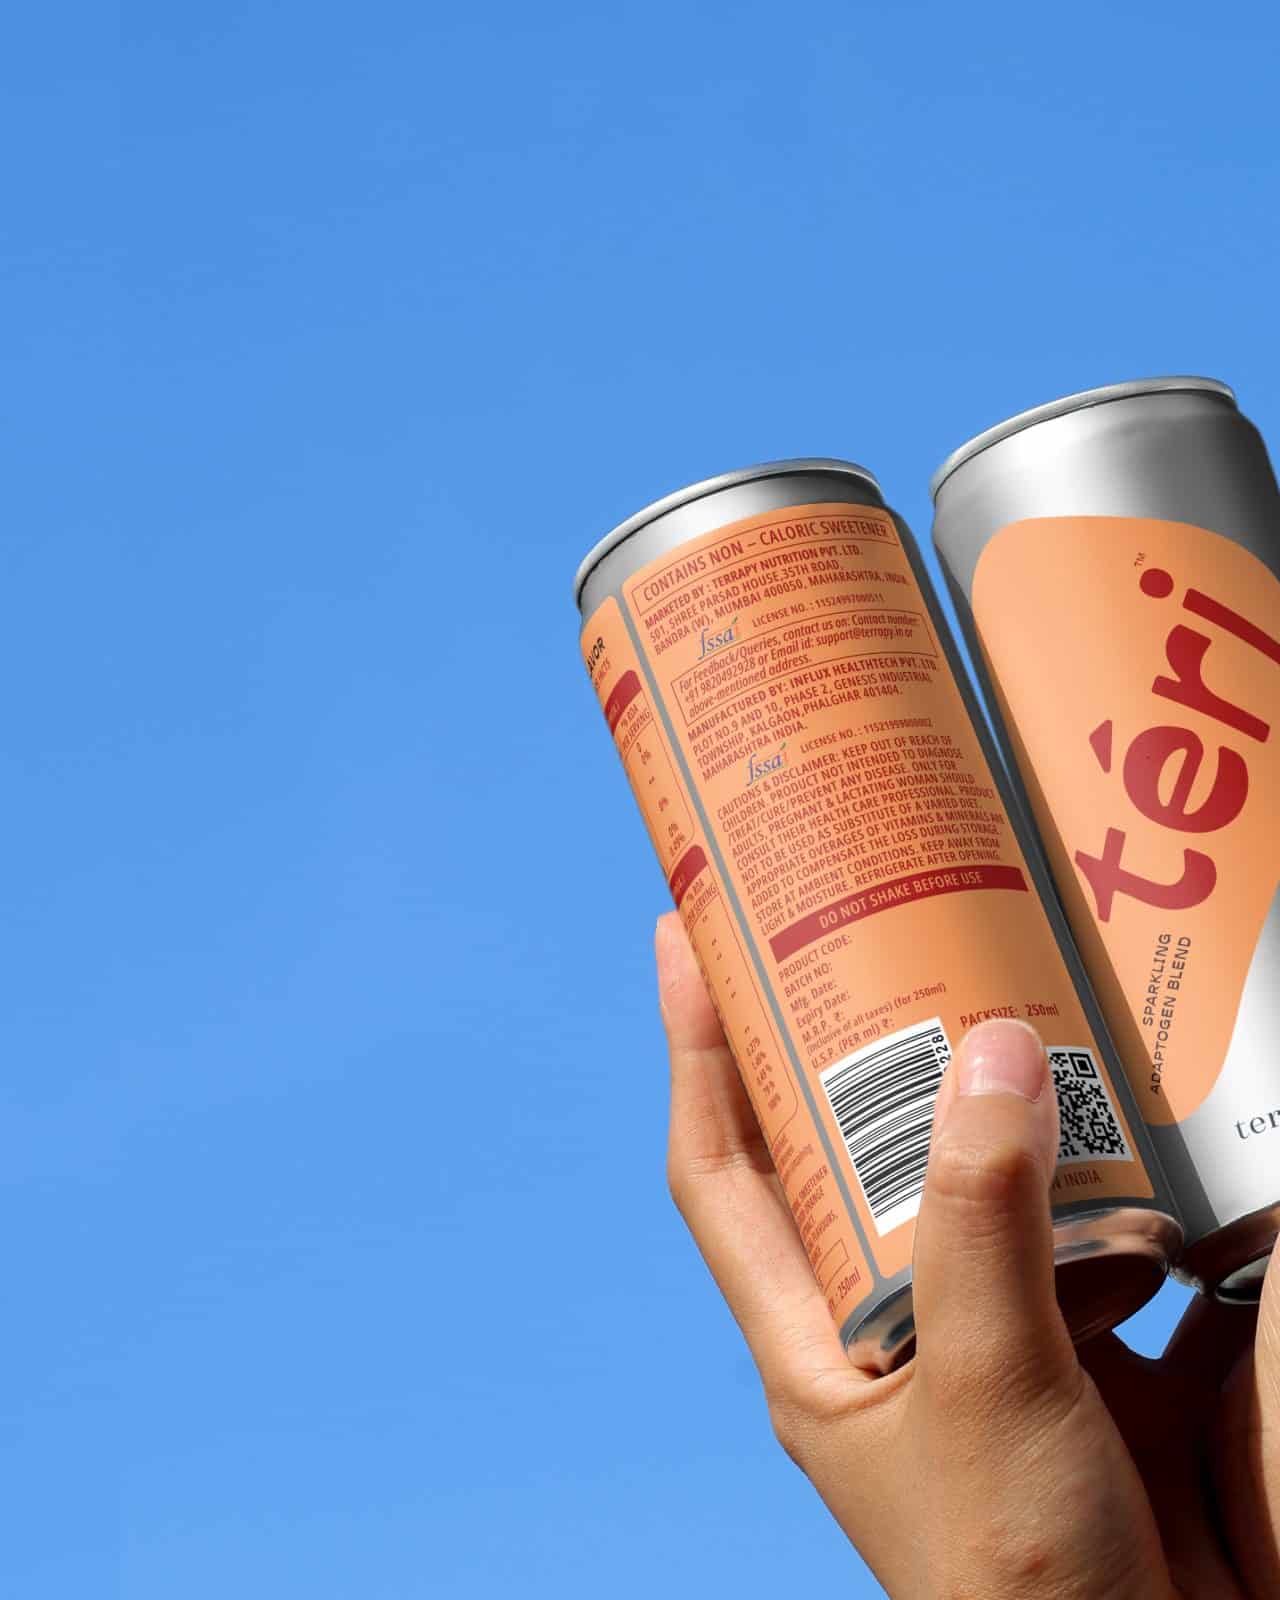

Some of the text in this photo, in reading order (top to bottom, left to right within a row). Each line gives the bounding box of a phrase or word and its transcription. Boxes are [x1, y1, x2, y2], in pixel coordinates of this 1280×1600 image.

[643, 556, 706, 602] CONTAINS
[709, 541, 743, 564] NON
[759, 525, 818, 546] CALORIC
[821, 524, 888, 537] SWEETENER
[645, 549, 818, 629] MARKETED BY TERRAPY NUTRITION
[655, 626, 690, 655] BANDRA
[715, 592, 761, 619] MUMBAI
[763, 580, 806, 599] 400050,
[669, 606, 698, 630] SHREE
[700, 586, 740, 612] PARSAD
[752, 608, 788, 628] LICENSE
[679, 676, 693, 692] For
[782, 623, 820, 640] contact
[834, 618, 851, 627] on:
[688, 653, 811, 718] above-mentioned address.
[700, 639, 814, 694] 9820492928 Email id:
[688, 660, 898, 742] MANUFACTURED BY: INFLUX HEALTHTECH
[693, 675, 877, 757] PLOT NO.9 AND 10, PHASE 2, GENESIS
[698, 732, 748, 770] TOWNSHIP,
[703, 720, 807, 782] MAHARASHTRA INDIA.
[717, 739, 891, 821] CAUTIONS DISCLAIMER: KEEP OUT
[819, 872, 982, 929] DO NOT SHAKE BEFORE USE
[778, 933, 851, 983] PRODUCT CODE:
[784, 961, 832, 998] BATCH NO:
[1143, 933, 1172, 1026] SPARKLING
[824, 989, 850, 1012] Date:
[960, 1004, 1059, 1026] PACKSIZE: 250ml
[1150, 936, 1192, 1095] ADAPTOGEN BLEND
